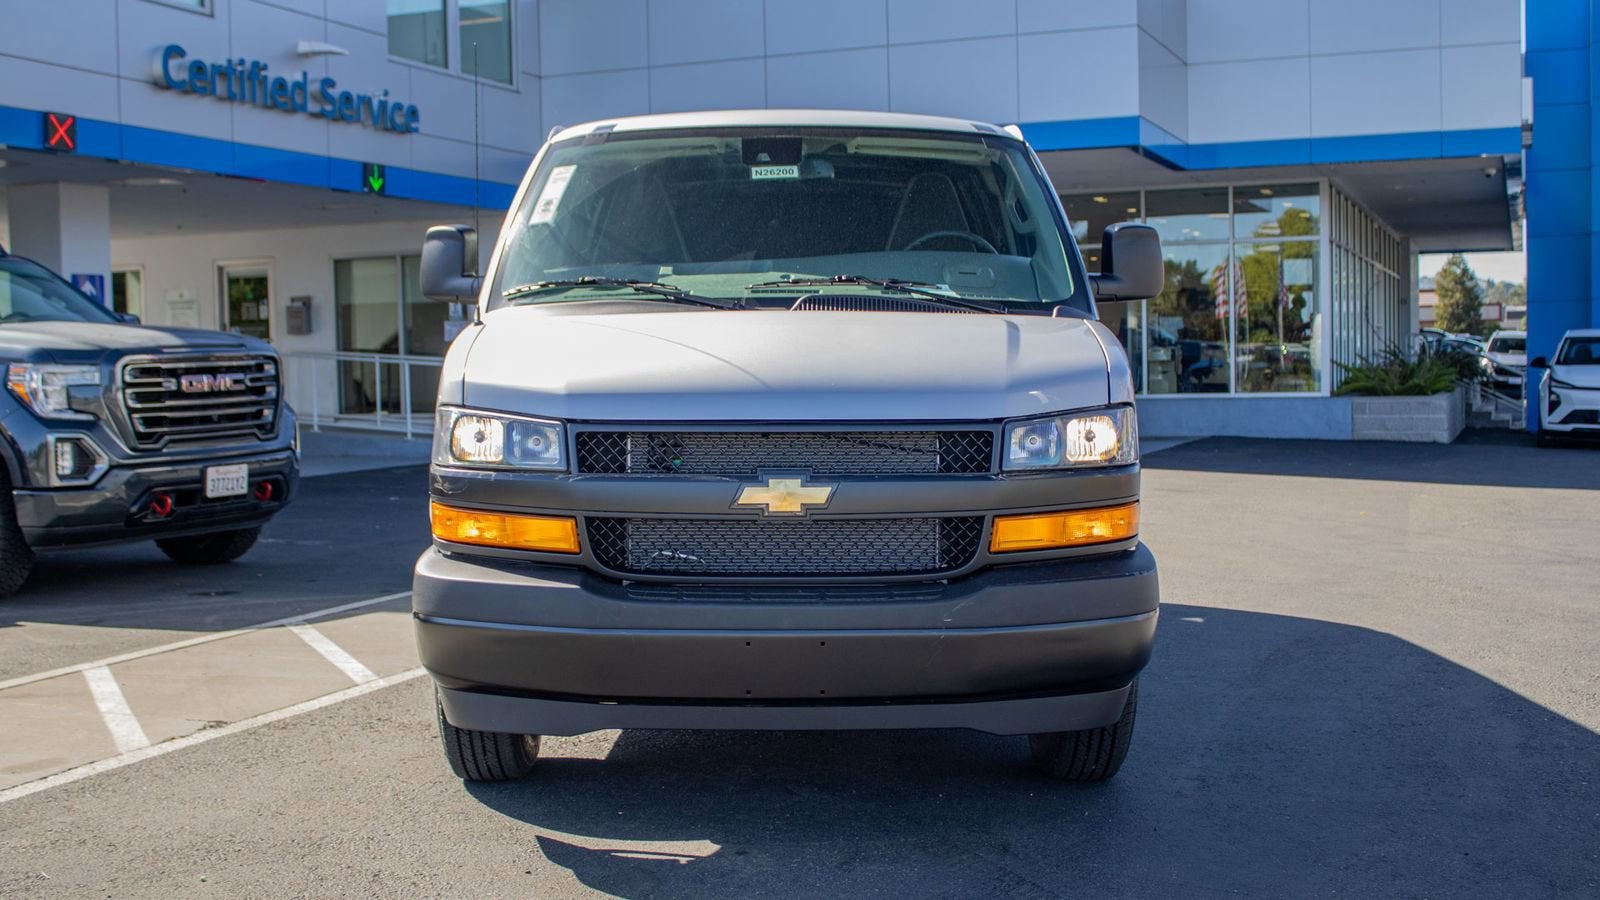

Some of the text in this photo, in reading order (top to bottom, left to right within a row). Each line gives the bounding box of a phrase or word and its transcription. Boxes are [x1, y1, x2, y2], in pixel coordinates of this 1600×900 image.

[162, 45, 420, 133] Certified Service
[755, 168, 794, 176] N26200
[181, 373, 246, 392] GMC
